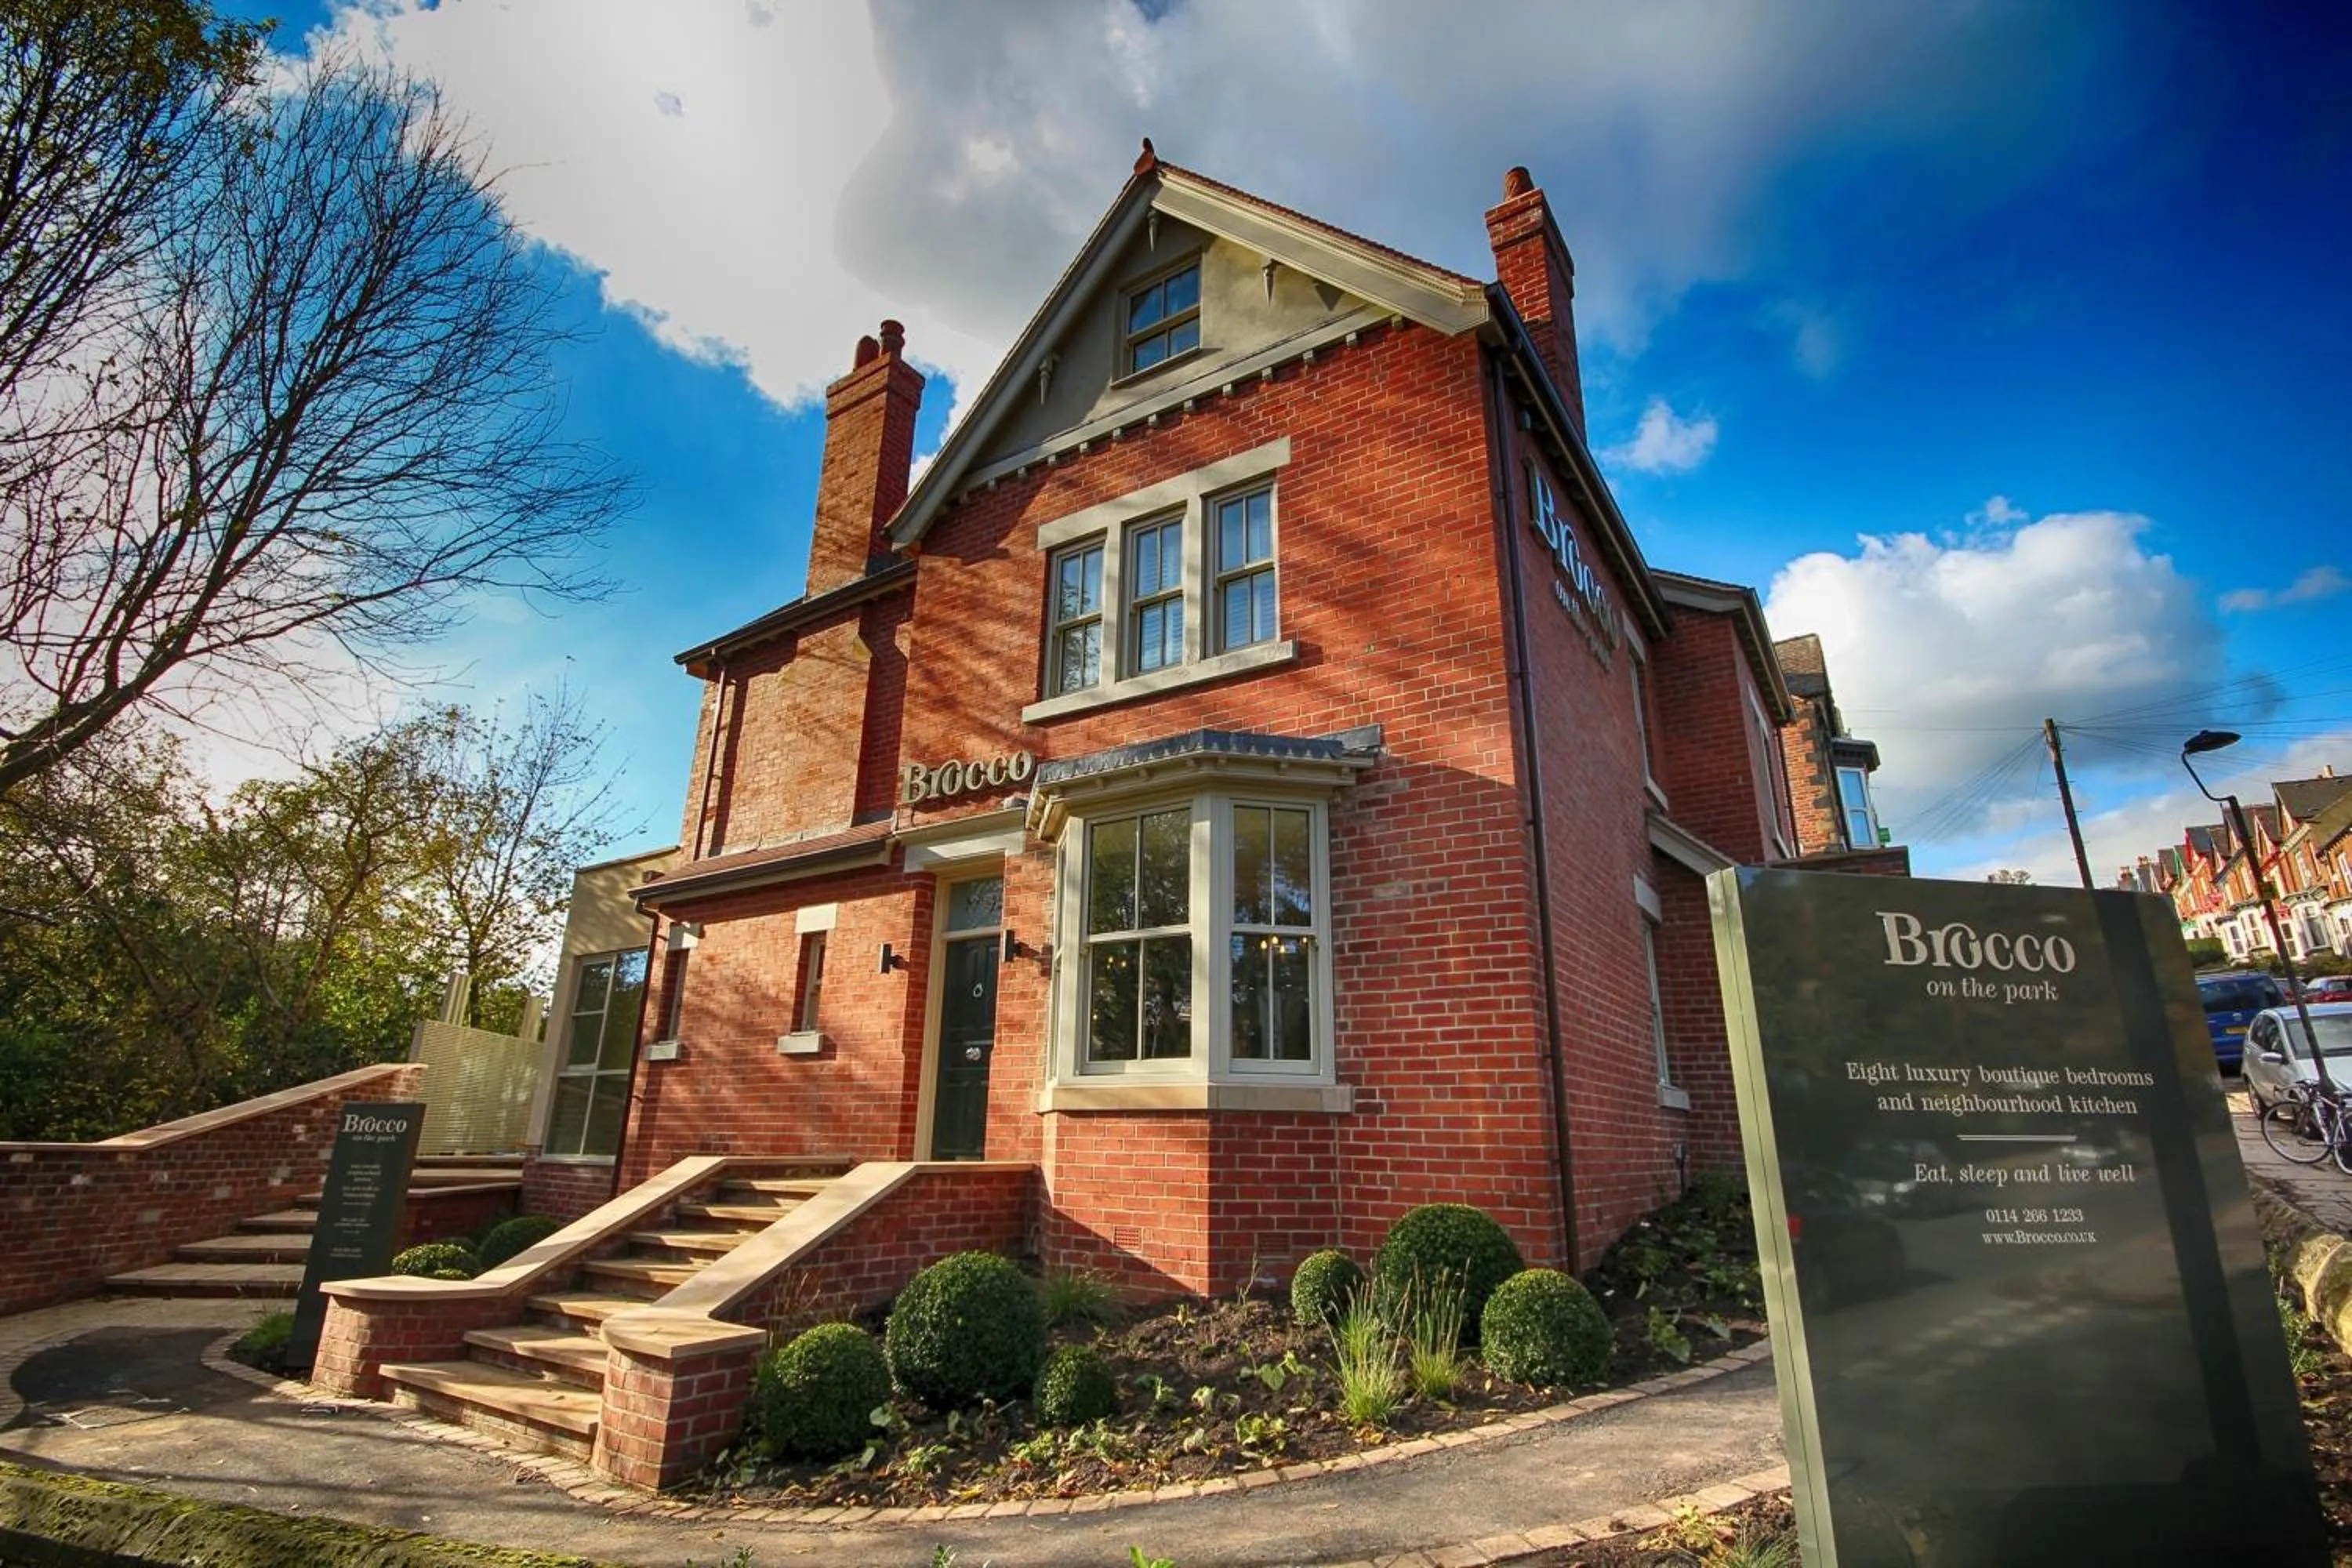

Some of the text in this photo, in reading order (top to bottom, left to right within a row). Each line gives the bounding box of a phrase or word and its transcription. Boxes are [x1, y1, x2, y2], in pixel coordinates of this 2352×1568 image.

[902, 749, 1033, 804] Brocco
[1875, 911, 2076, 973] Brocco
[1926, 978, 2059, 1004] on the park
[1845, 1062, 2154, 1089] Eight luxury boutique bedrooms
[1877, 1093, 2138, 1116] and neighbourhood kitchen
[341, 1114, 407, 1133] Brocco
[1914, 1163, 2136, 1187] Eat, sleep and live well
[1985, 1207, 2084, 1223] 0114 266 1233
